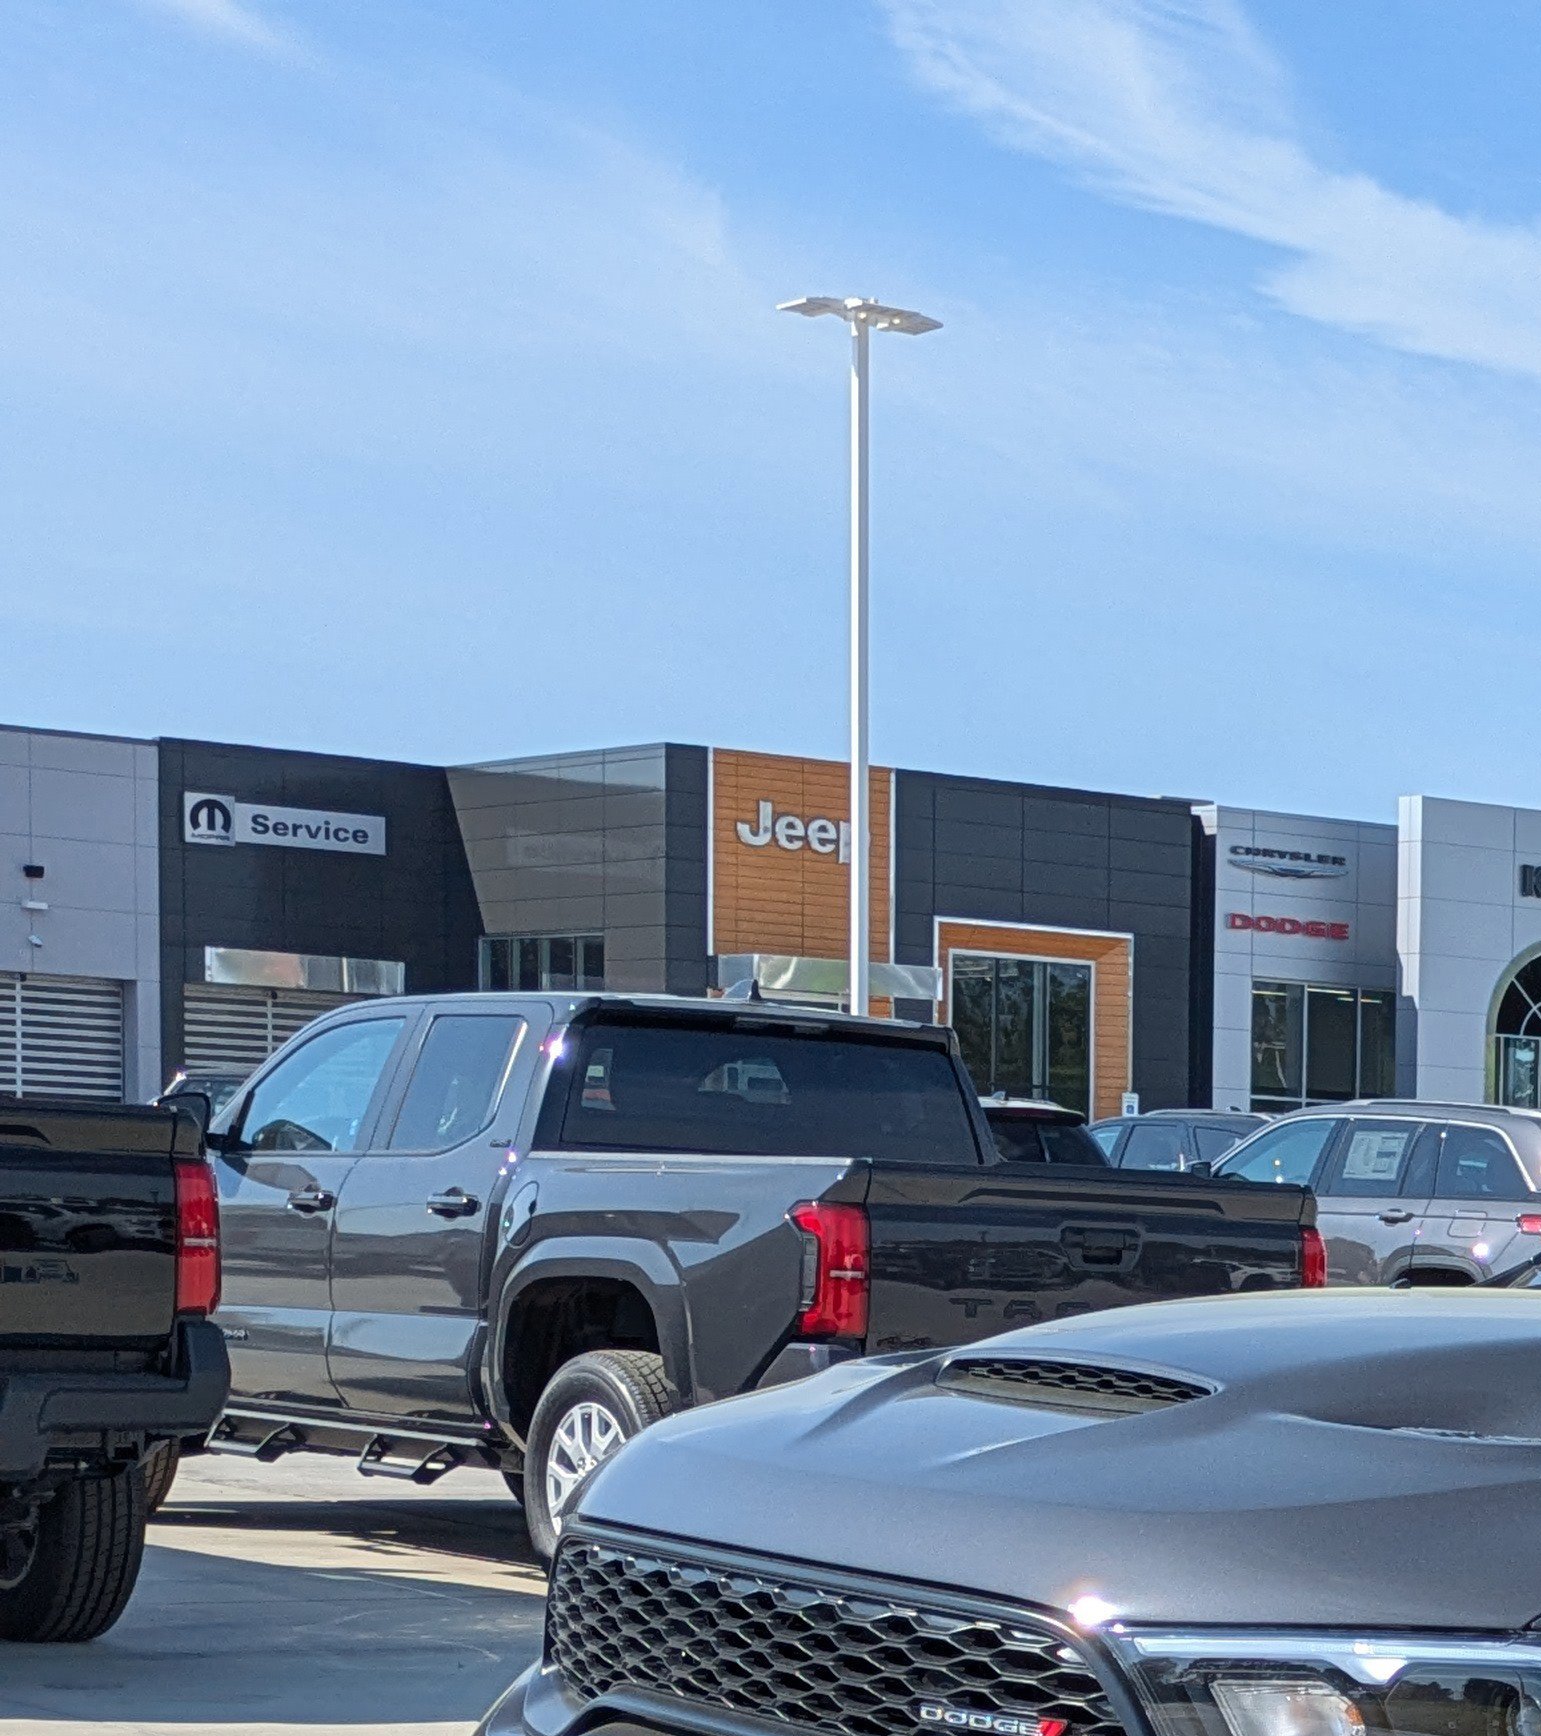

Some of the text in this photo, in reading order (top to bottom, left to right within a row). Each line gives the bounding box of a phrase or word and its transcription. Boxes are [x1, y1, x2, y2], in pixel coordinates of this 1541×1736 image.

[251, 813, 369, 844] Service
[1229, 845, 1346, 866] CHRYSLER
[1227, 912, 1349, 940] DODGE
